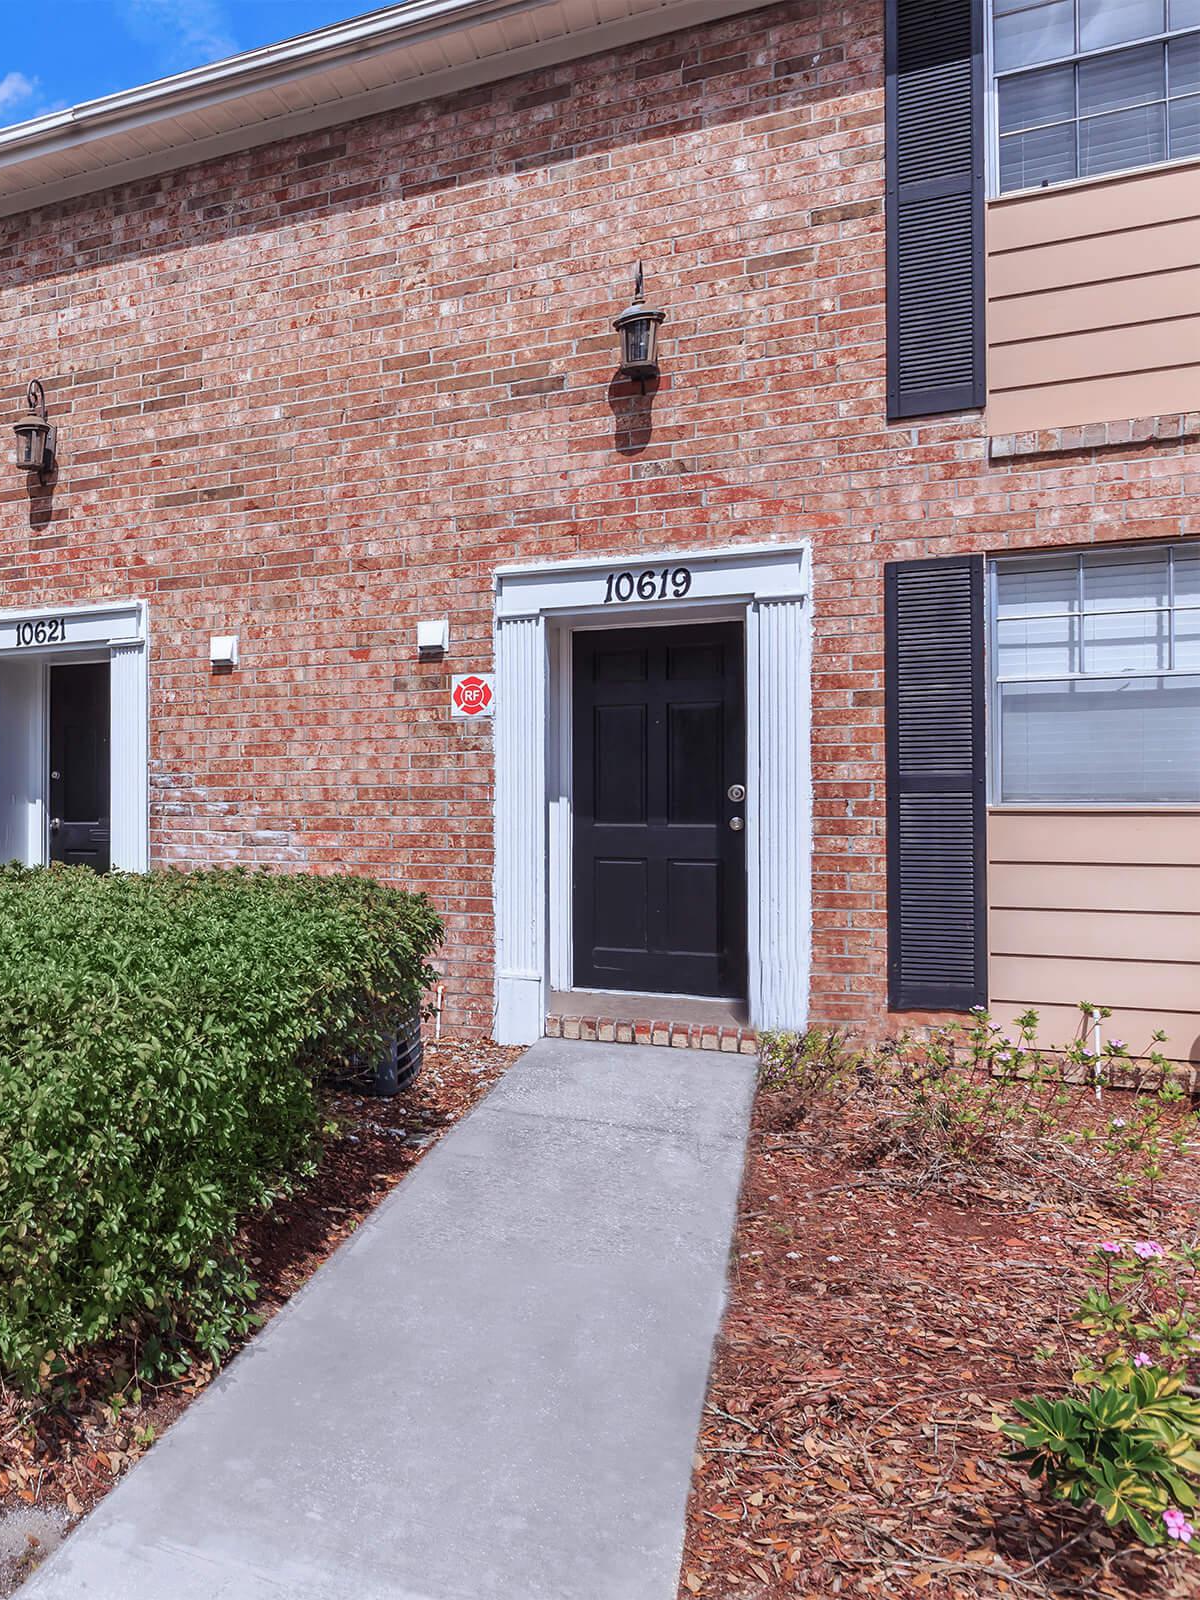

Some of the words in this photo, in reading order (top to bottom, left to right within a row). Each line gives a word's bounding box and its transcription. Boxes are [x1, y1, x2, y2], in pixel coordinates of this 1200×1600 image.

[604, 568, 691, 603] 10619
[16, 618, 66, 646] 10621
[465, 690, 480, 701] RF
